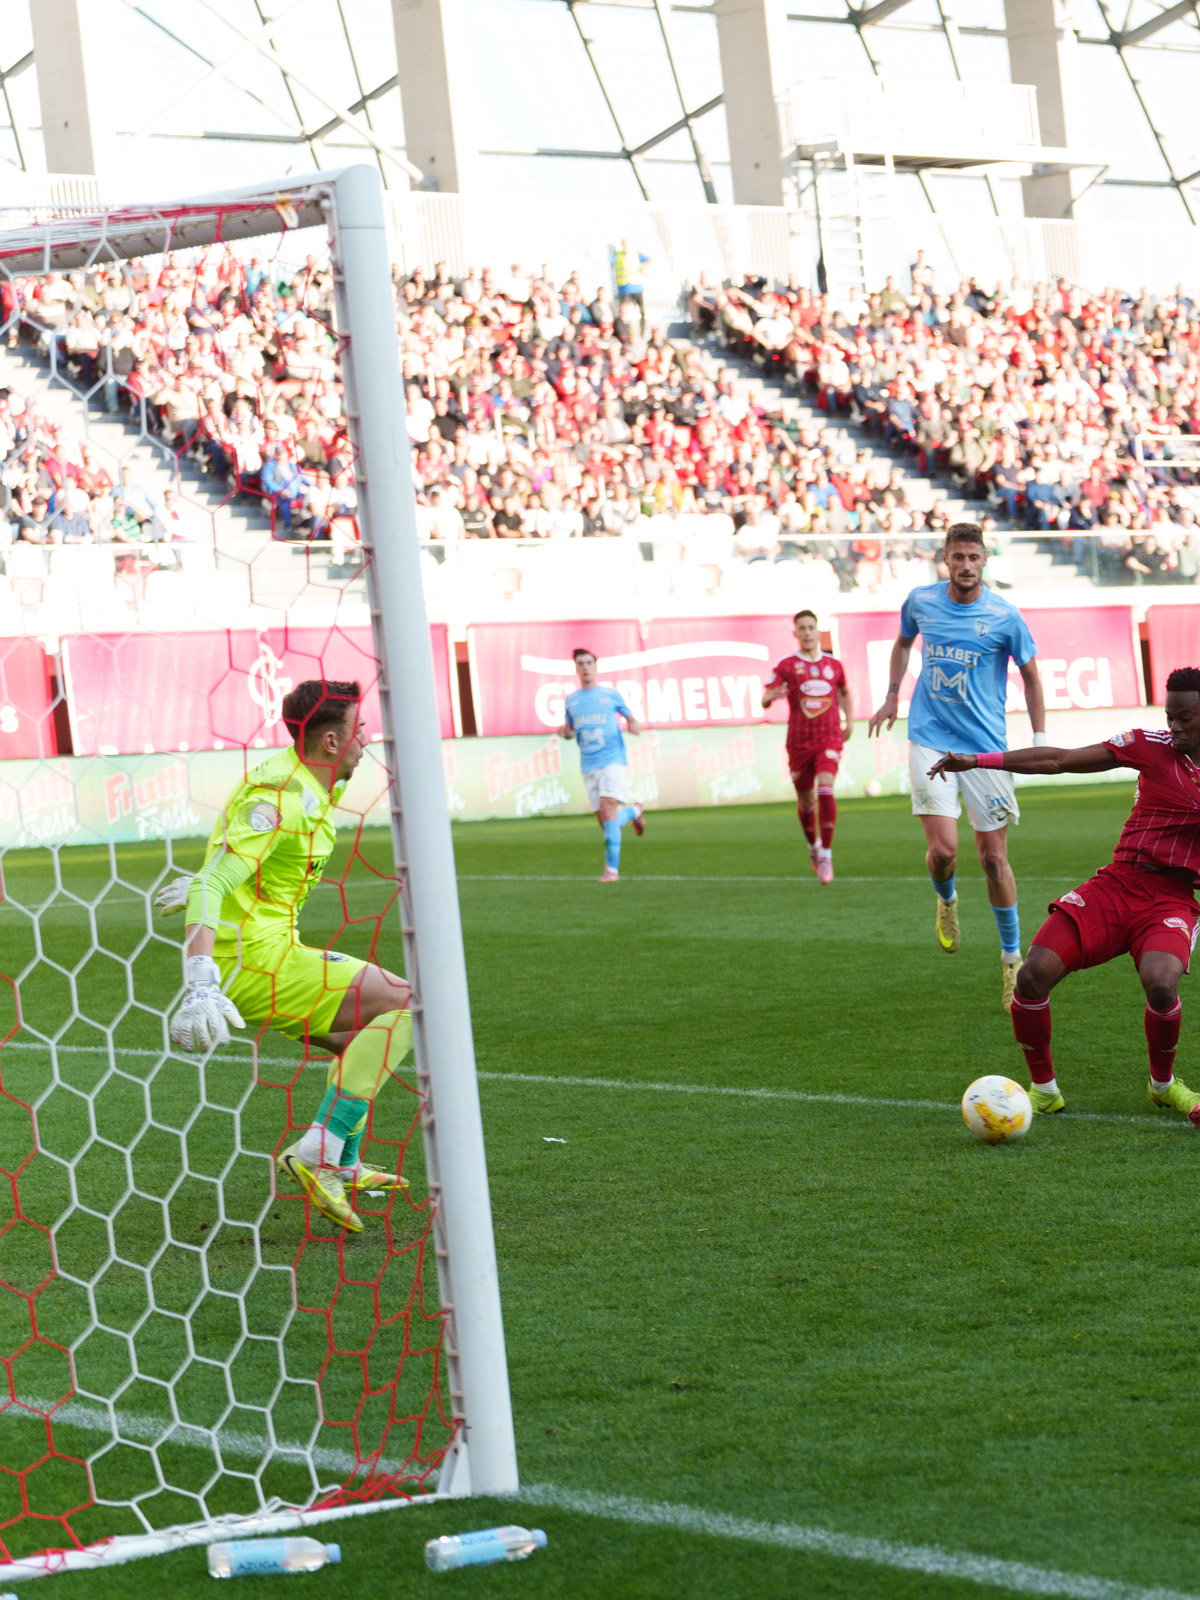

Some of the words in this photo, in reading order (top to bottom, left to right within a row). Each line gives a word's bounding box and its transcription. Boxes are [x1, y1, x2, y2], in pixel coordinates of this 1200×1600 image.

[924, 642, 982, 667] MAXBET
[103, 754, 189, 826] Frutti
[484, 736, 562, 802] Frutti
[238, 1559, 280, 1570] AZUGA
